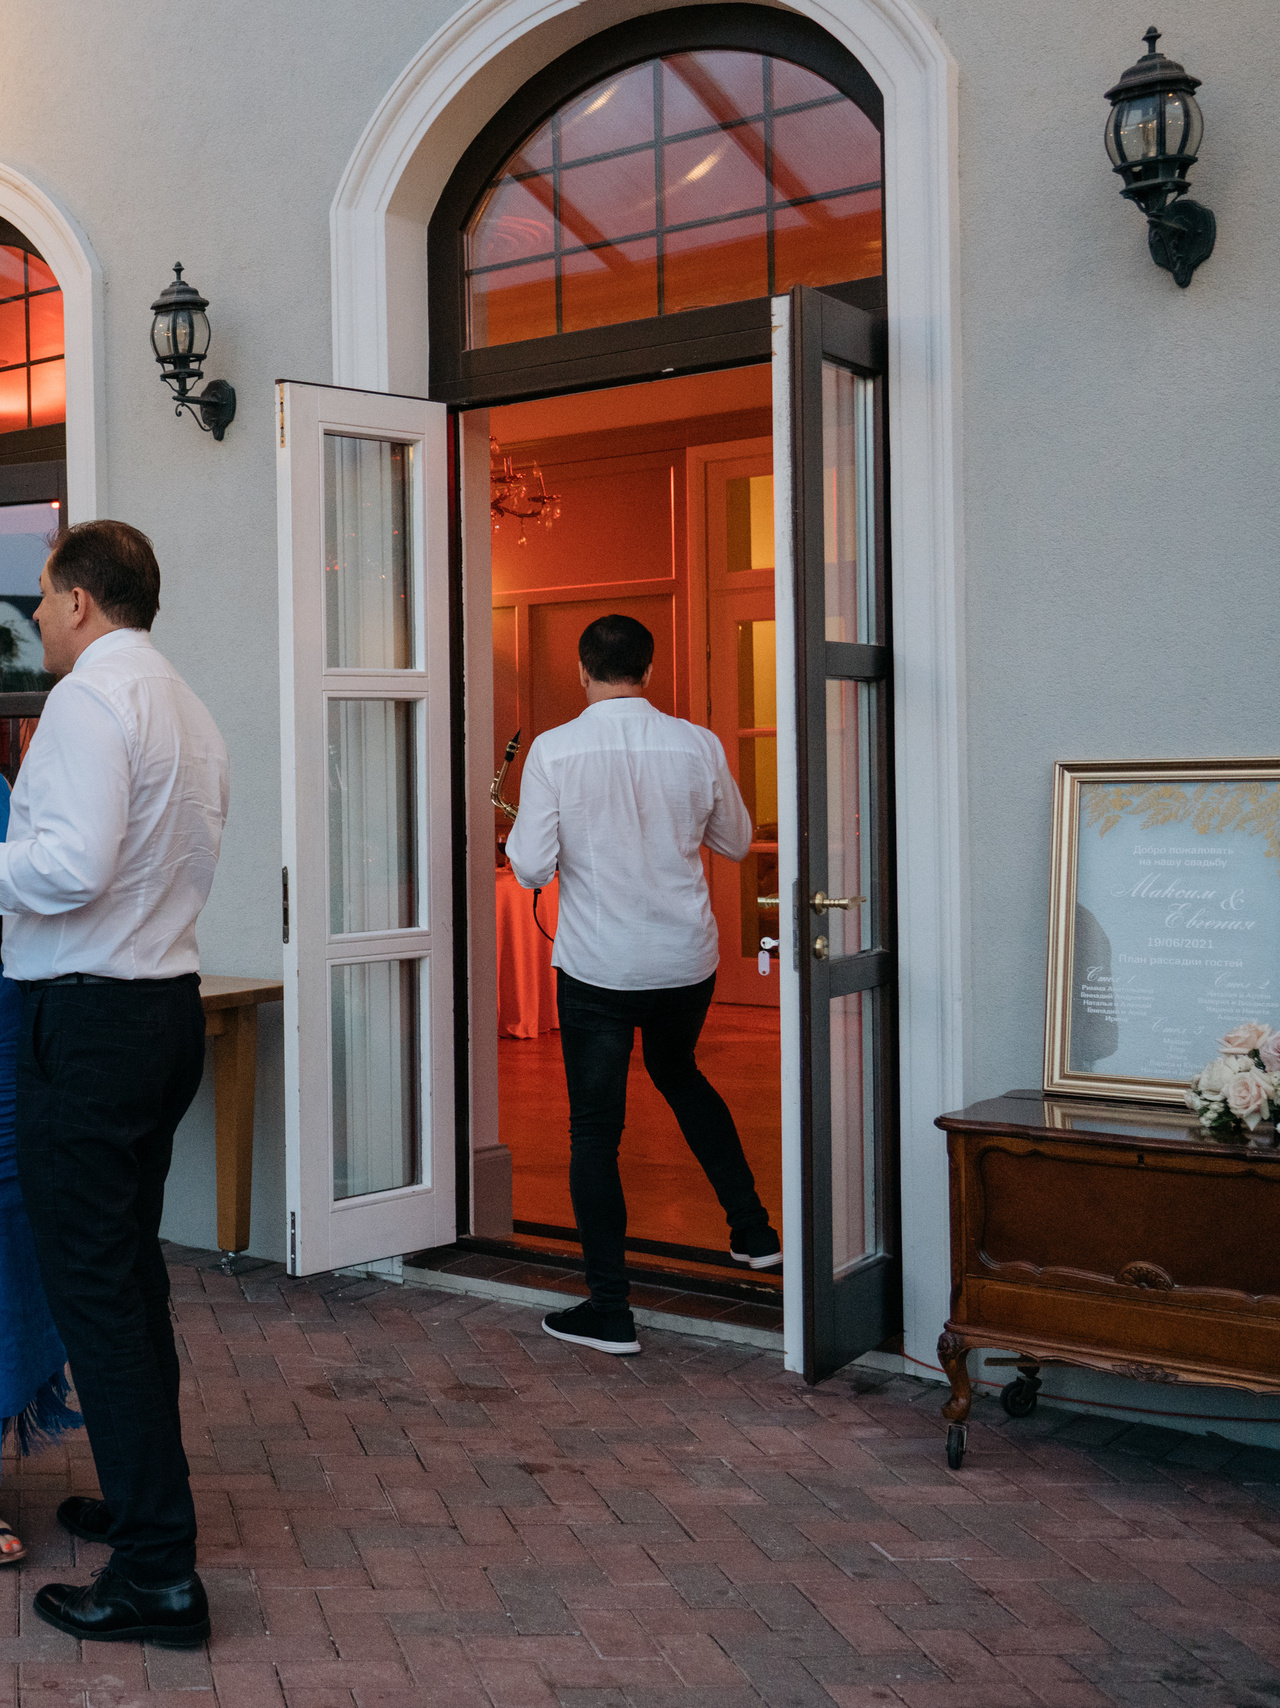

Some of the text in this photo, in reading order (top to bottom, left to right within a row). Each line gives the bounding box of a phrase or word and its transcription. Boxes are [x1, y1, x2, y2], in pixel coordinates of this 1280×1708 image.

[1133, 845, 1234, 856] Добро пожаловать
[1139, 857, 1228, 869] на нашу свадьбу
[1110, 871, 1245, 911] Максим &
[1164, 902, 1256, 931] Евгения
[1147, 937, 1214, 949] 19/06/2021
[1118, 953, 1244, 968] План рассадки гостей
